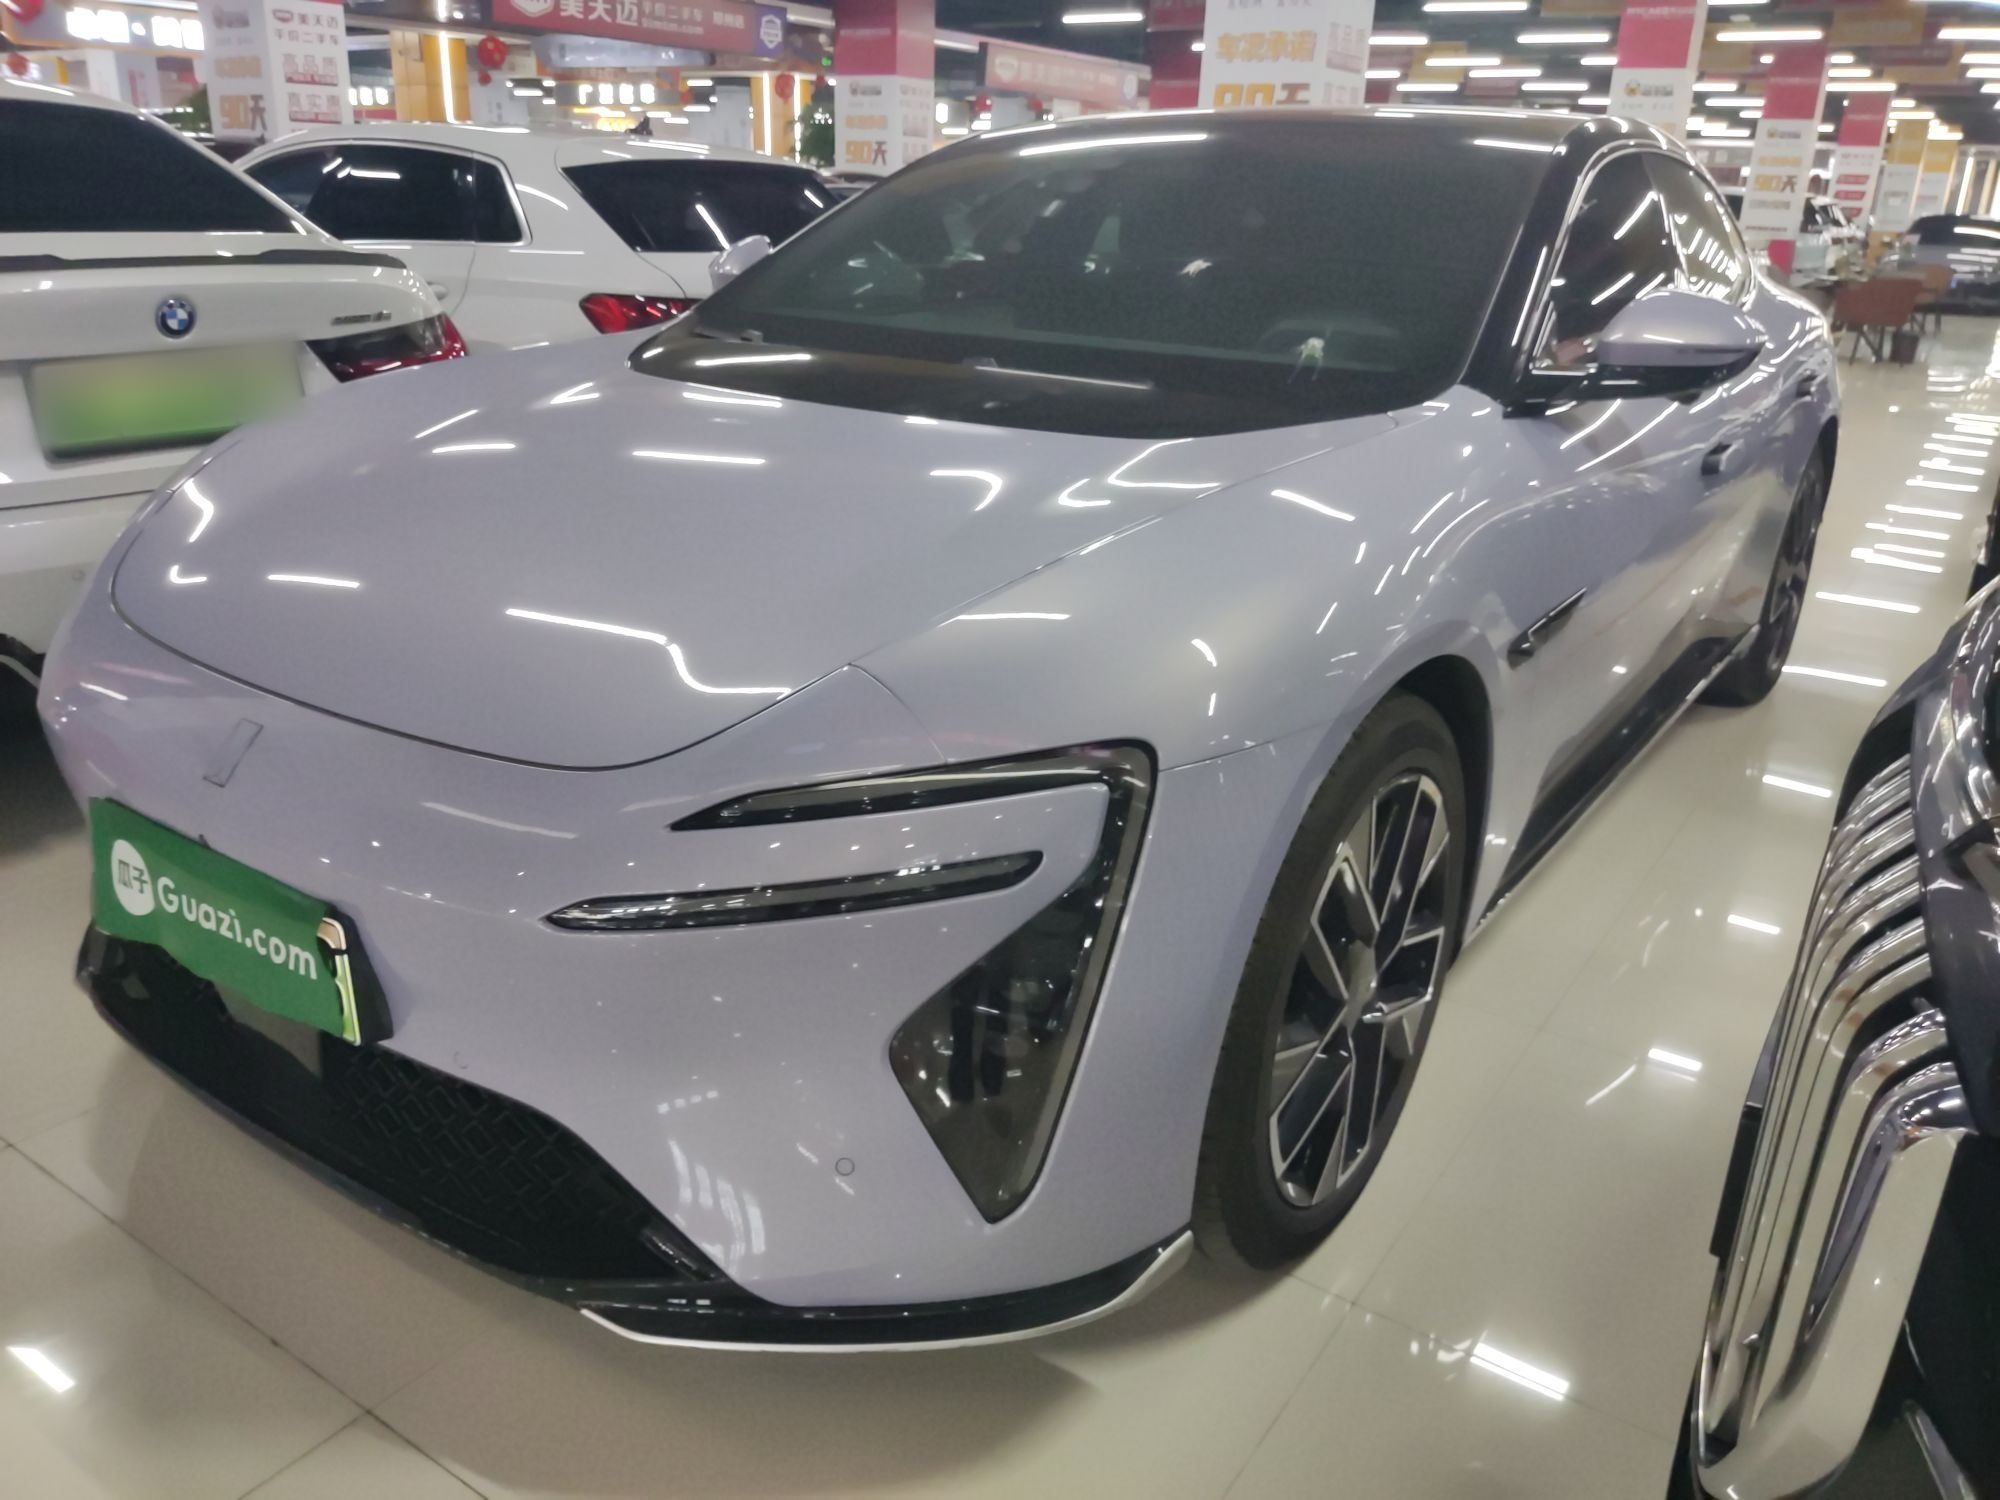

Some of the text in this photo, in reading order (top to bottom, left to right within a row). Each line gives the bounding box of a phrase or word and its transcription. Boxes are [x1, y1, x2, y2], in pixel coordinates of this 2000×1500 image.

[219, 94, 267, 131] 90天
[845, 140, 888, 165] 90天
[116, 857, 149, 895] 瓜子
[156, 875, 319, 981] Guazi.com
